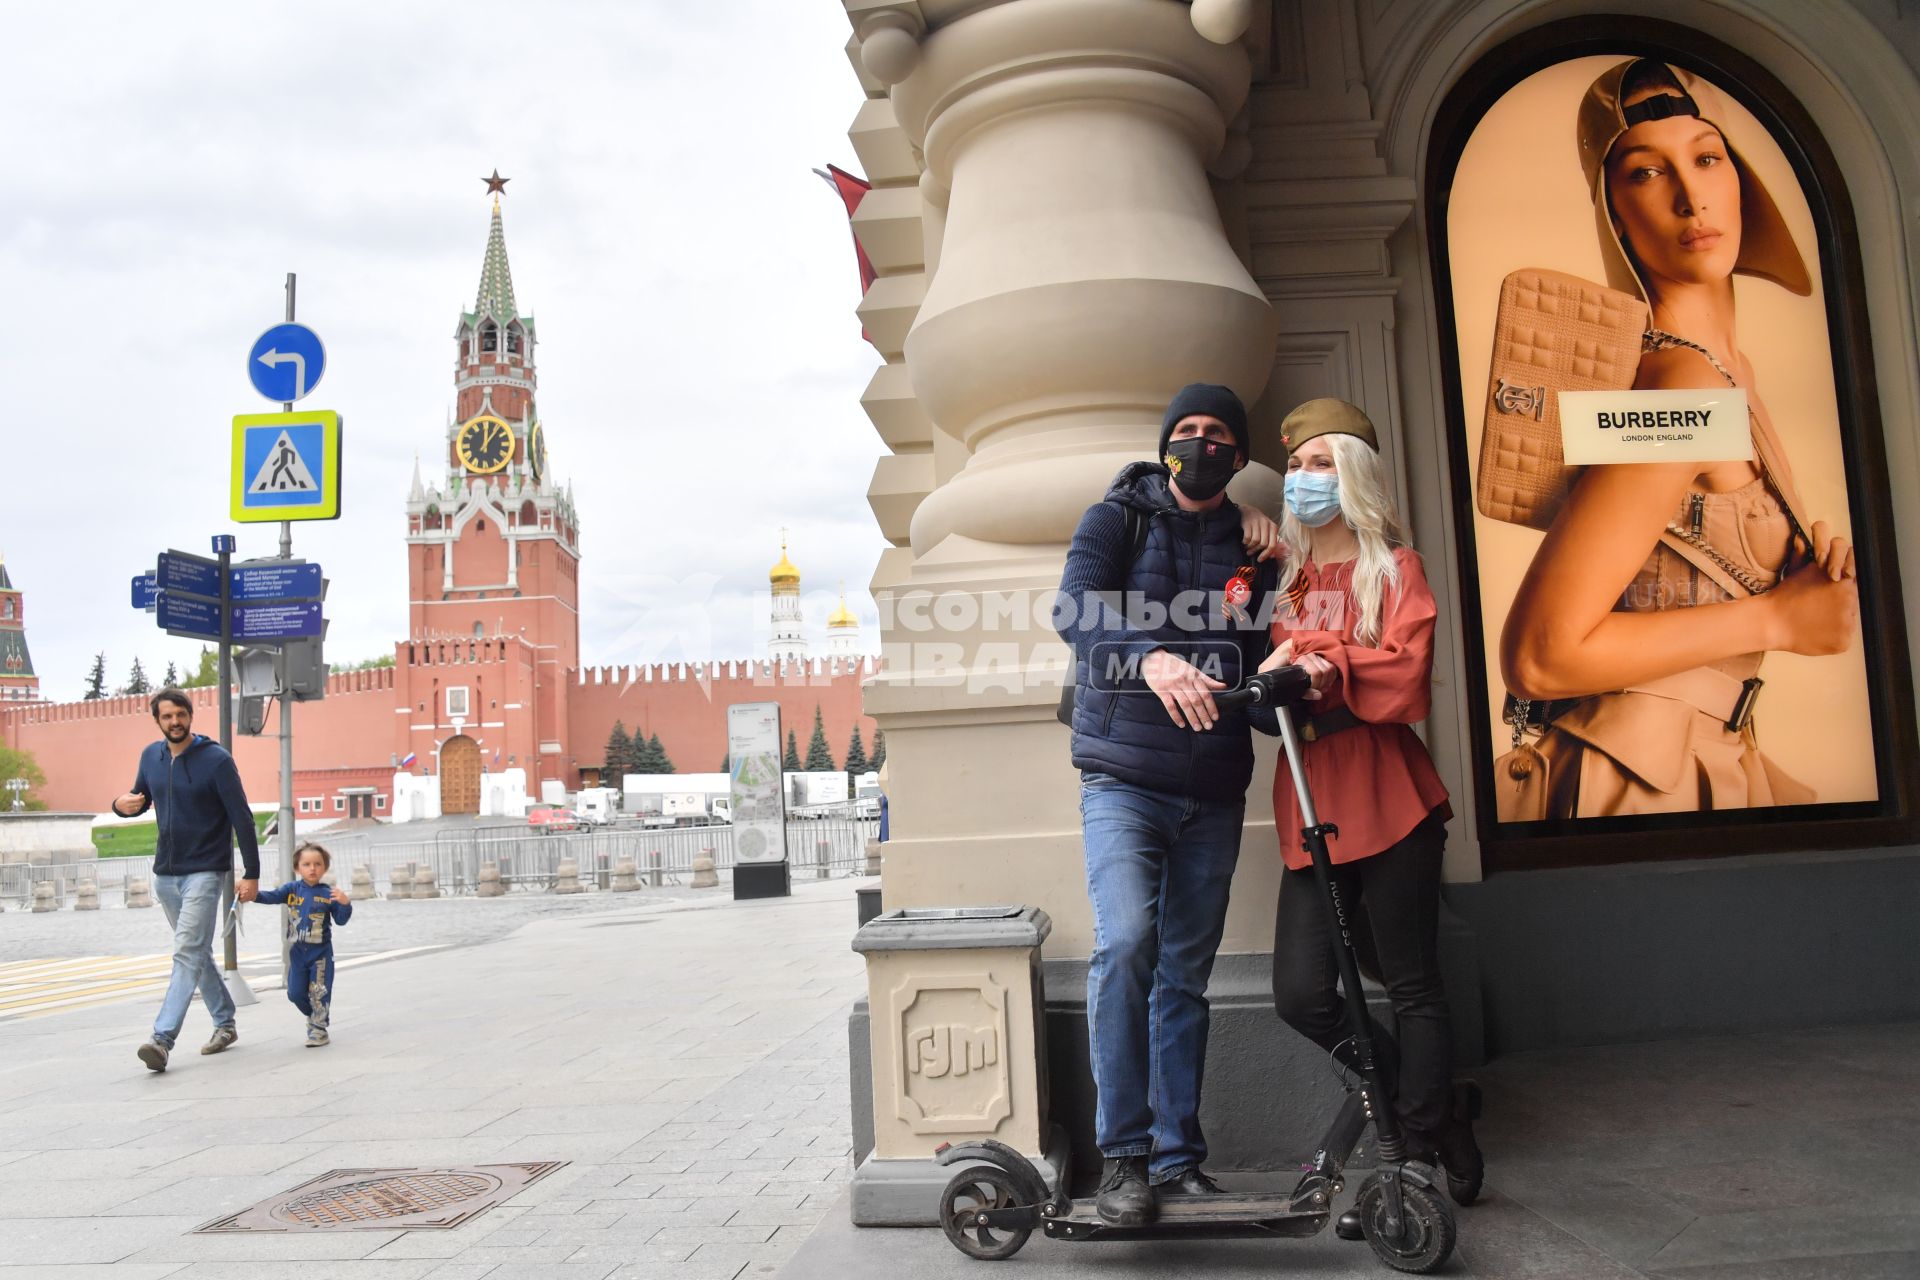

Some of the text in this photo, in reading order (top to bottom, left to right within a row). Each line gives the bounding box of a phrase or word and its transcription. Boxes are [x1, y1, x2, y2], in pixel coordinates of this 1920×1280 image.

[1597, 410, 1711, 429] BURBERRY
[1621, 433, 1693, 442] LONDON ENGLAND
